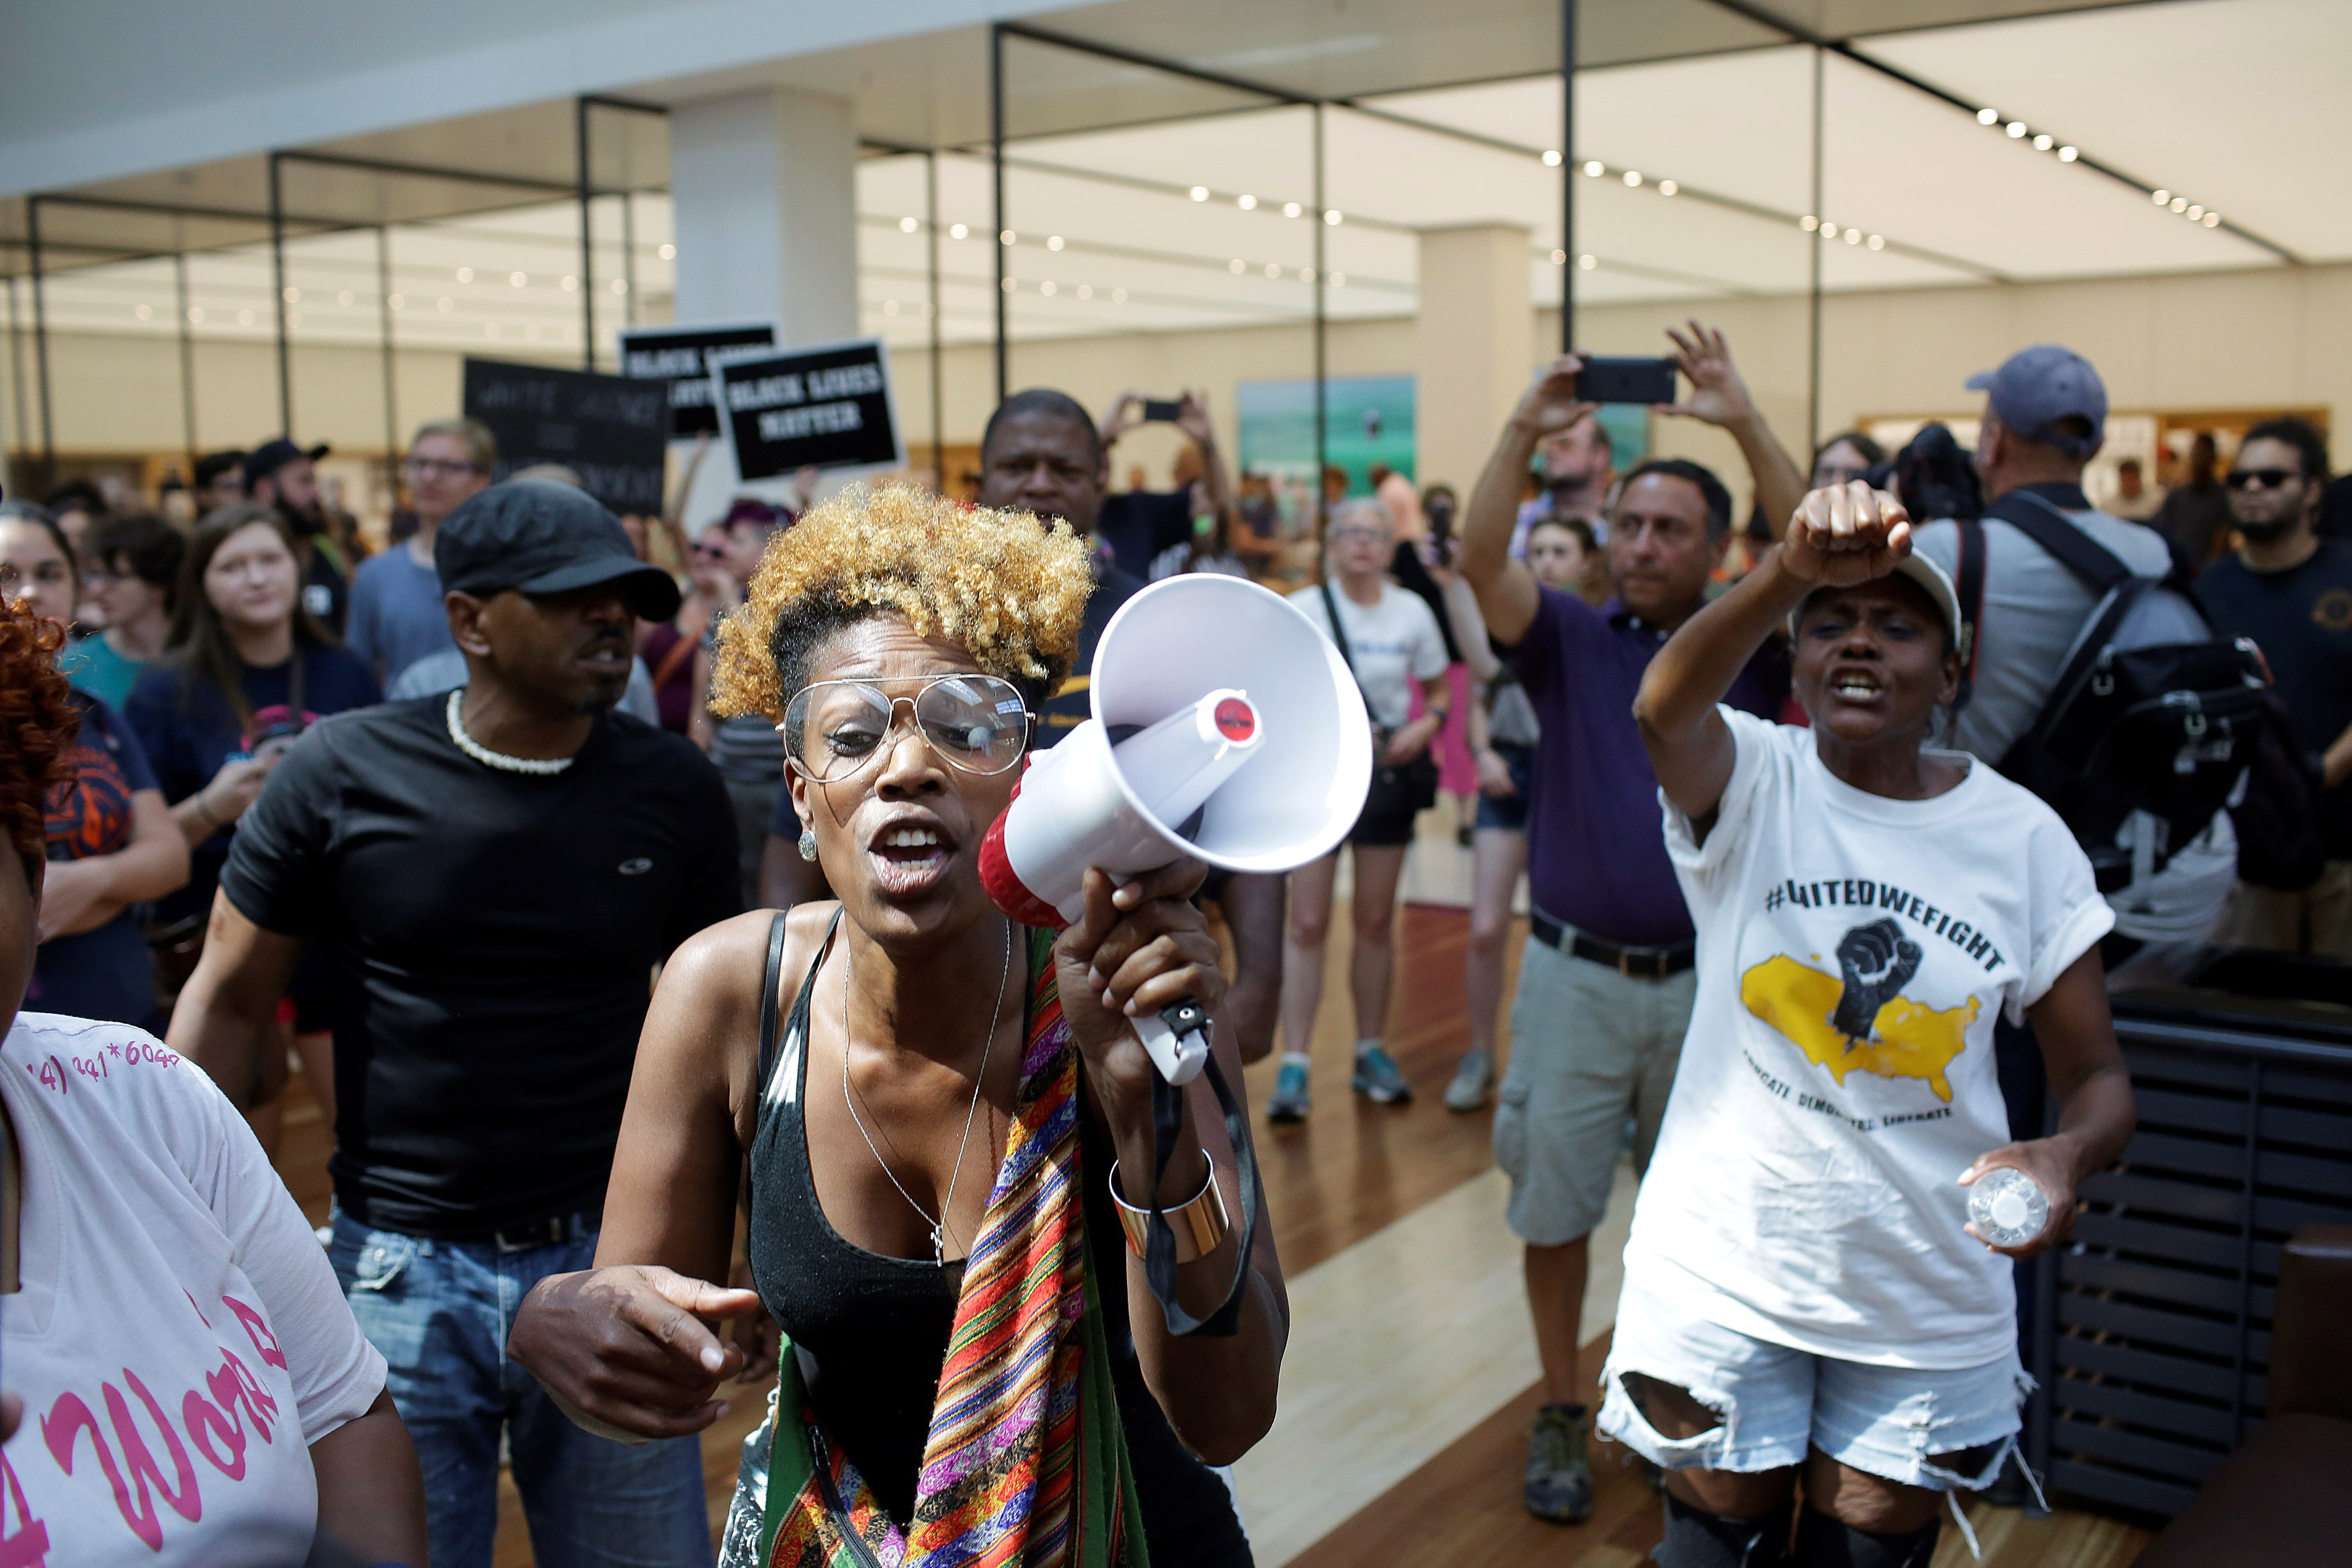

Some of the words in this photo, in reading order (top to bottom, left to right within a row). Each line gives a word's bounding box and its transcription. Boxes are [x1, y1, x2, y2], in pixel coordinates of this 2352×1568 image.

[728, 378, 806, 412] BLACK
[807, 363, 885, 401] LIVES
[759, 401, 861, 441] MATTER
